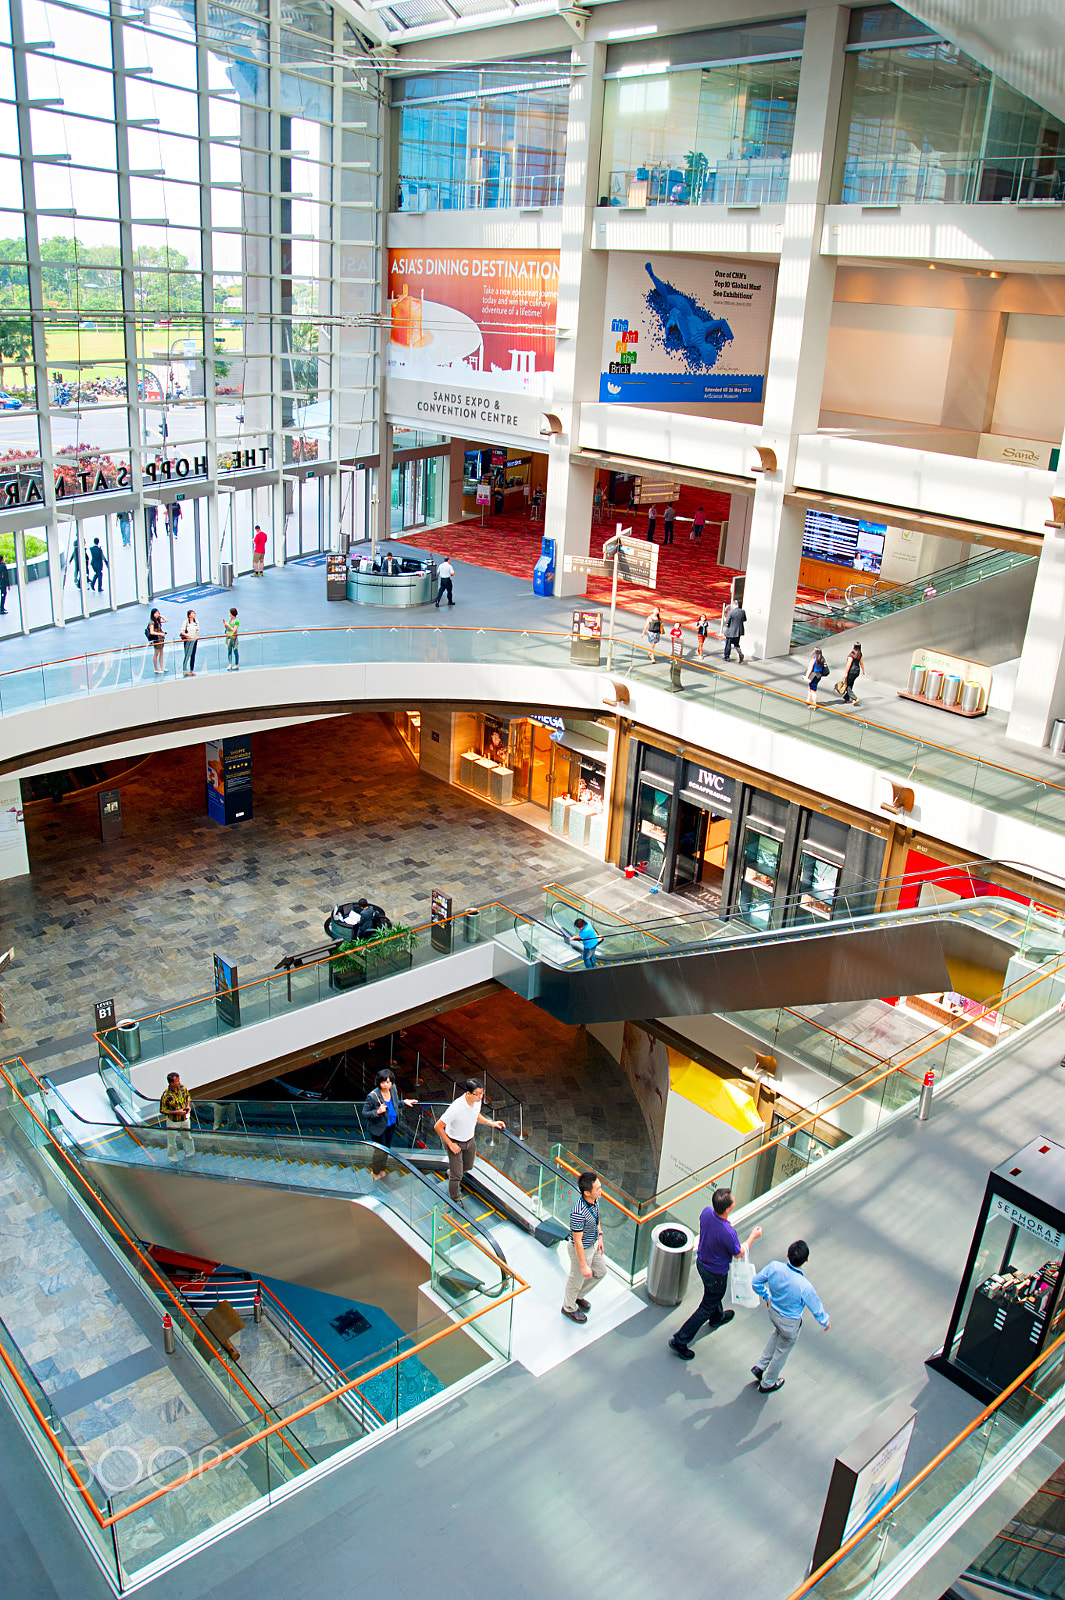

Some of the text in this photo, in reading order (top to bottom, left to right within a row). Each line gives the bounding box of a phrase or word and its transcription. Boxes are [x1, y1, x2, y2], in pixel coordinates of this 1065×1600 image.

[391, 258, 560, 280] ASIA'S DINING DESTINATION
[714, 270, 725, 278] One
[714, 280, 724, 288] Top
[483, 285, 494, 294] Take
[512, 287, 538, 297] epicurean
[482, 296, 551, 309] today and win the culinary
[481, 305, 507, 315] adventure
[508, 306, 515, 316] of
[519, 307, 543, 318] lifetime!
[612, 321, 627, 331] The
[625, 333, 636, 343] Art
[617, 343, 625, 352] of
[623, 354, 635, 364] the
[611, 364, 629, 374] Brick
[433, 391, 500, 410] SANDS EXPO &
[417, 401, 518, 427] CONVENTION CENTRE
[1002, 447, 1040, 461] Sands
[698, 769, 725, 791] IWC
[96, 1000, 113, 1009] LEVEL
[98, 1006, 112, 1019] B1
[997, 1201, 1052, 1238] SEPHORA
[1026, 1225, 1044, 1238] BEAUTY
